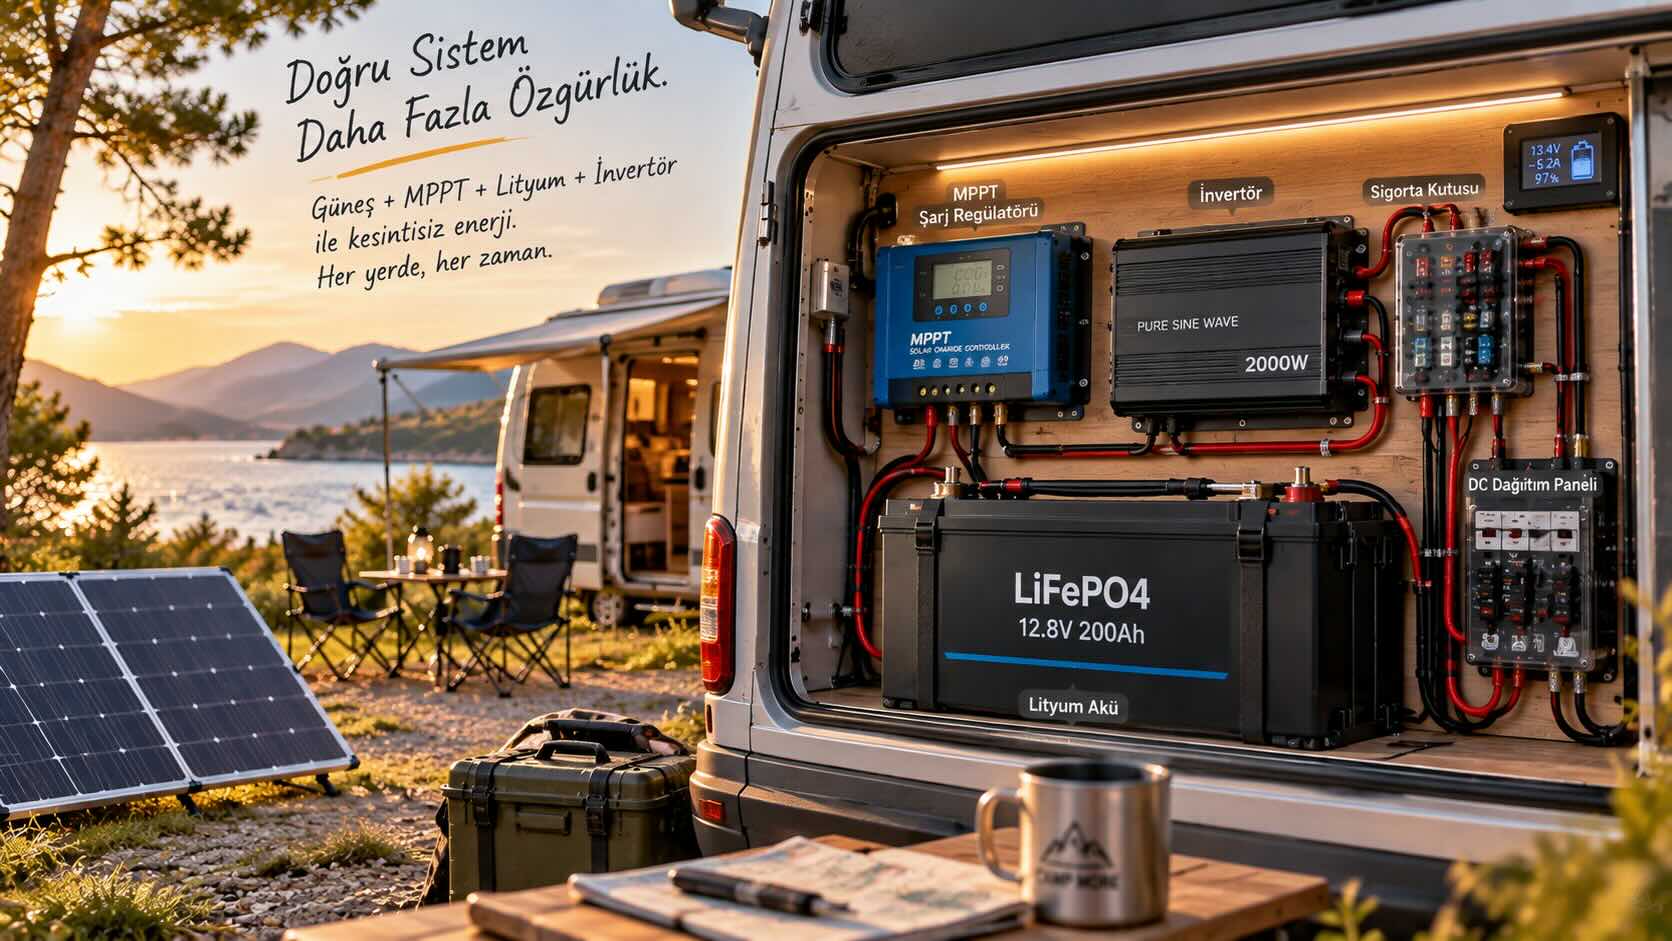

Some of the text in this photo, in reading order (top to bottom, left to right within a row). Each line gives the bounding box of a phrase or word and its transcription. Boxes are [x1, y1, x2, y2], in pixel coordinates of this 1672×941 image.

[1137, 315, 1239, 332] PURE SINE WAVE
[910, 330, 952, 346] MPPT
[1245, 354, 1309, 374] 2000W
[1014, 571, 1150, 610] LiFePO4
[1018, 618, 1145, 644] 12.8V 200Ah
